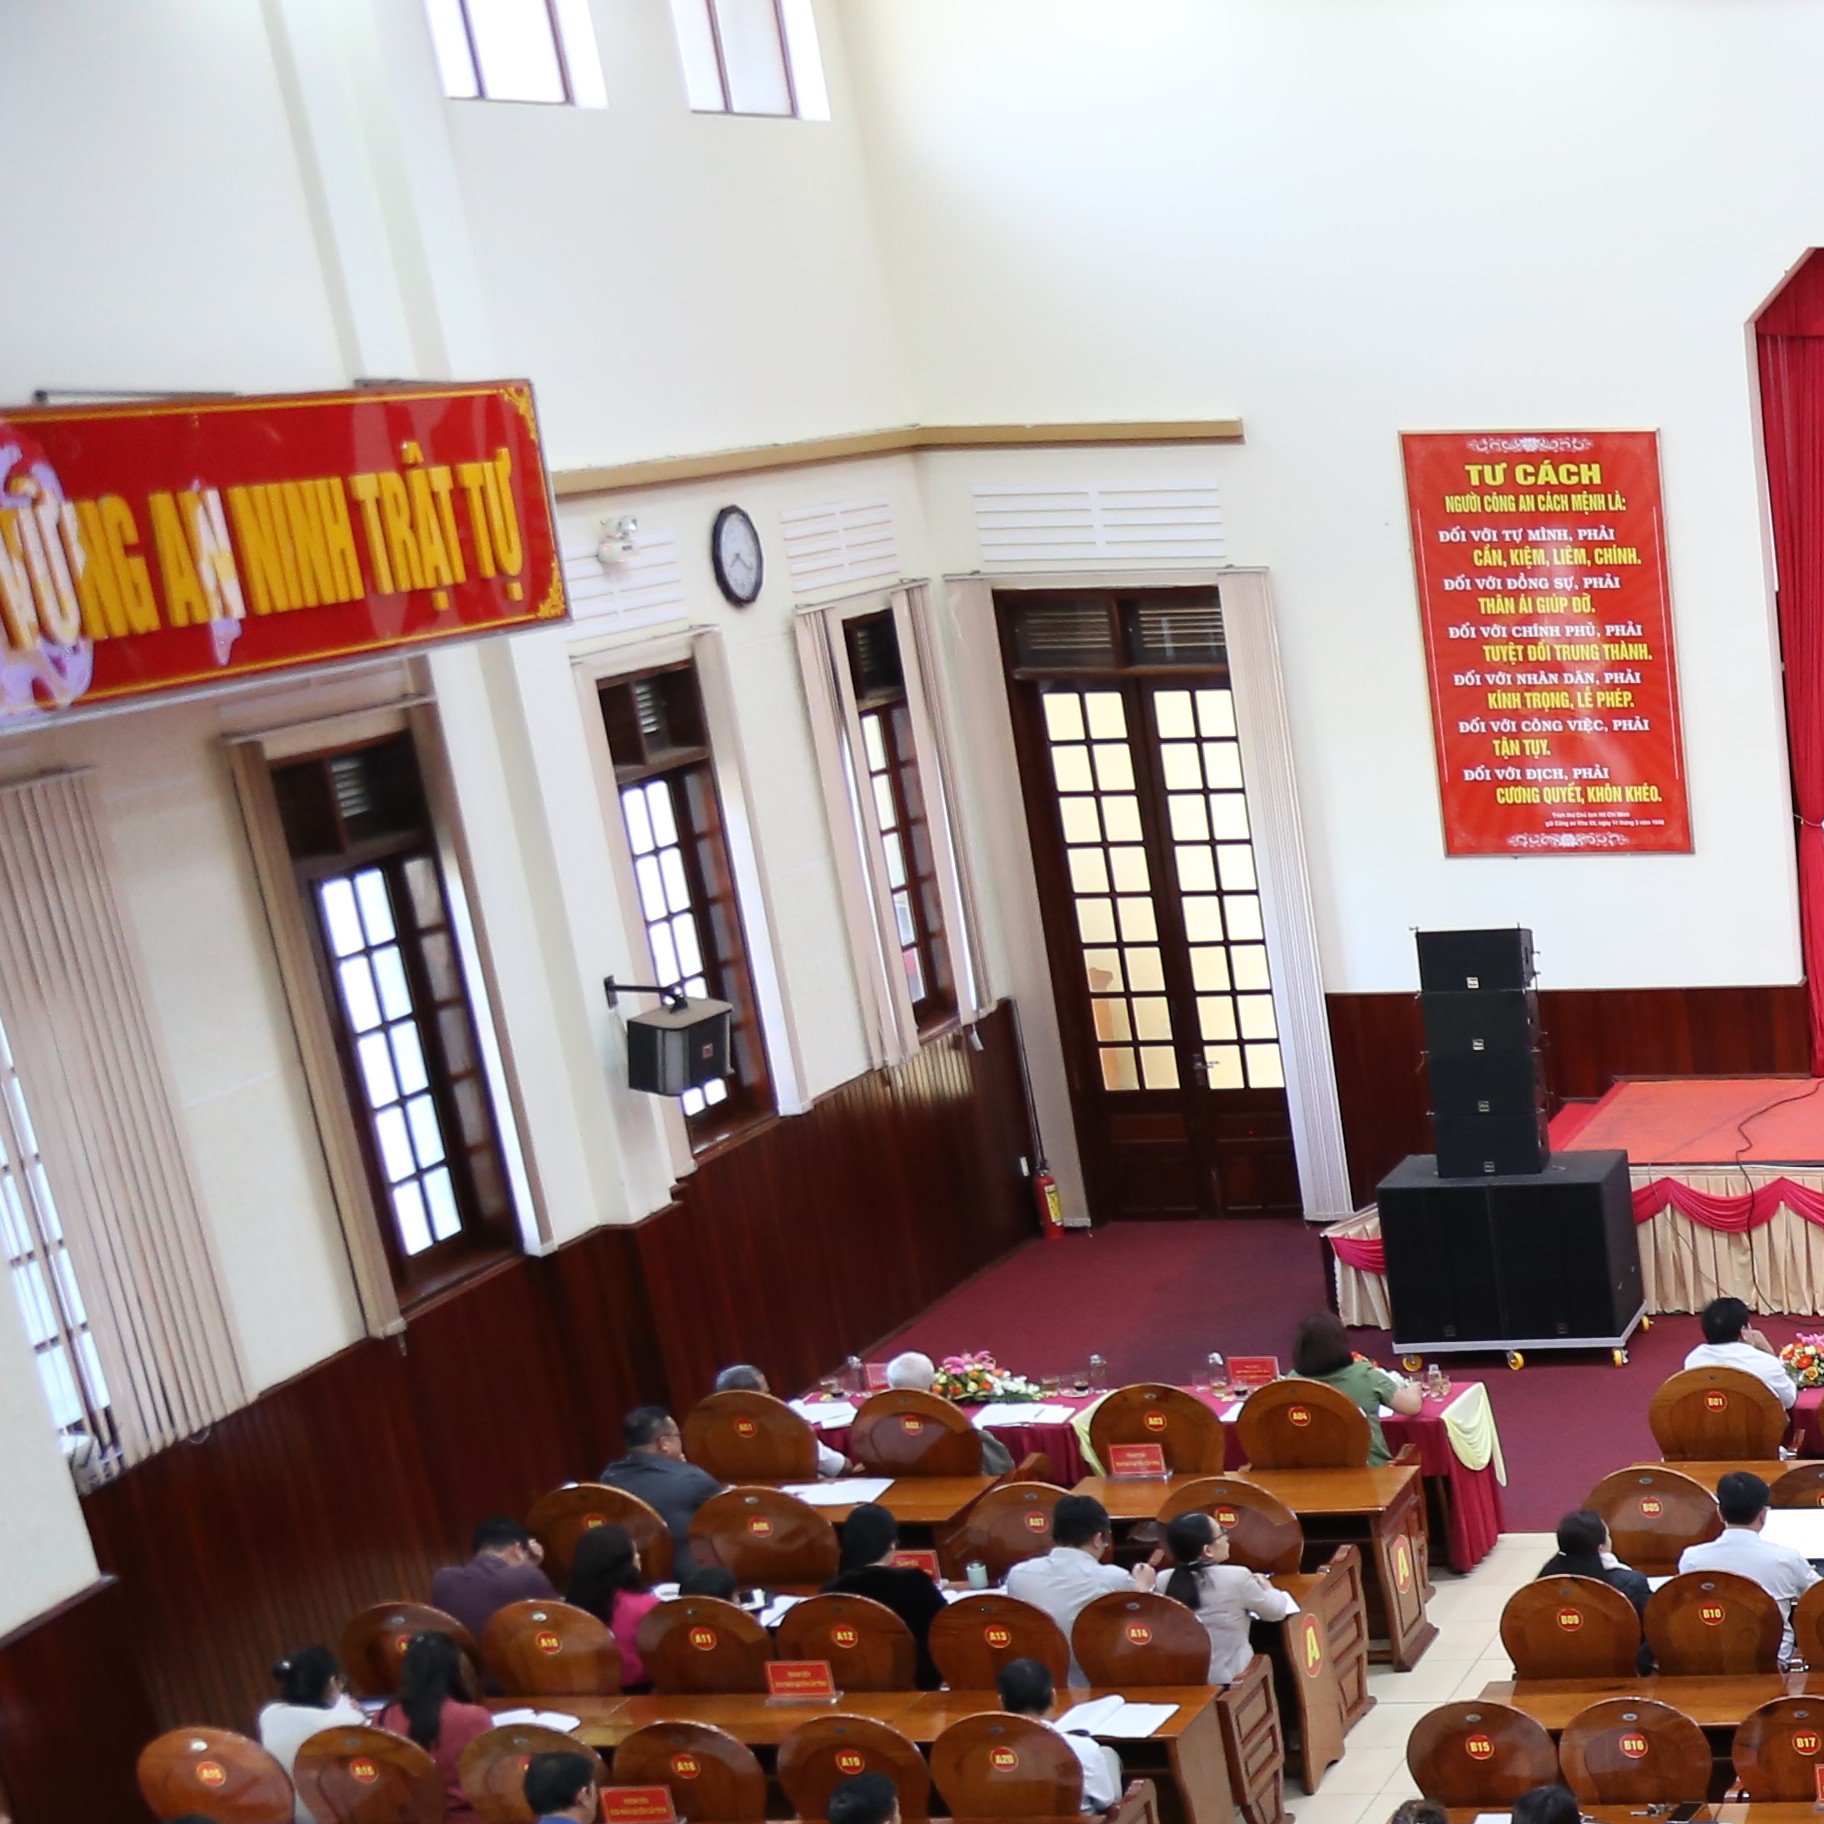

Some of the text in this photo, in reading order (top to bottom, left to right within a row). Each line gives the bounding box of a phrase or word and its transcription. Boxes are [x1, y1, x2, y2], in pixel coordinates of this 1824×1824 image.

[1465, 459, 1601, 486] TƯ CÁCH
[149, 489, 246, 627] AN
[227, 476, 365, 616] NINH
[349, 440, 467, 612] TRẬT
[456, 447, 524, 601] TỰ
[1439, 525, 1615, 543] ĐỐI VỚI TỰ MÌNH, PHẢI
[1443, 574, 1471, 590] ĐỐI
[1475, 576, 1502, 590] VỚI
[1554, 576, 1579, 592] SỰ,
[1583, 573, 1620, 588] PHẢI
[1449, 622, 1476, 638] ĐỐI
[1480, 624, 1507, 637] VỚI
[1512, 623, 1561, 637] CHÍNH
[1605, 621, 1643, 636] PHẢI
[1454, 669, 1641, 686] ĐỐI VỚI NHÂN DÂN, PHẢI
[1459, 716, 1649, 733] ĐỐI VỚI CÔNG VIỆC, PHẢI
[1463, 764, 1609, 782] ĐỐI VỚI ĐỊCH, PHẢI
[1396, 1554, 1411, 1584] A
[1702, 1608, 1722, 1619] B10
[1304, 1626, 1322, 1670] A
[1469, 1741, 1490, 1753] B15
[1623, 1739, 1644, 1751] B16
[1796, 1737, 1816, 1749] B17
